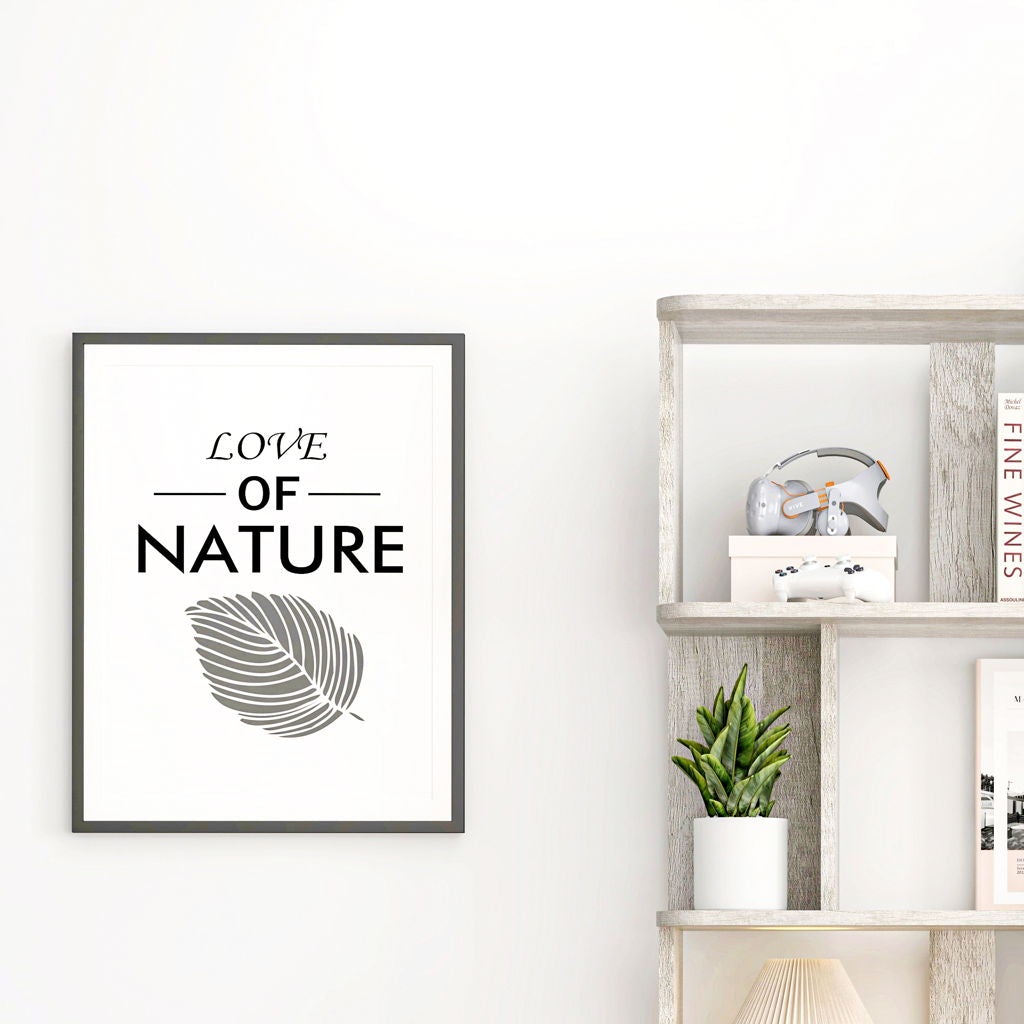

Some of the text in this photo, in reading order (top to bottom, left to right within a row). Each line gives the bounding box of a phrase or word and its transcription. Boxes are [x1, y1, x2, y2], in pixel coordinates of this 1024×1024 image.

[206, 427, 328, 460] LOVE
[238, 475, 300, 511] OF
[1003, 423, 1022, 578] FINE WINES
[138, 524, 404, 574] NATURE
